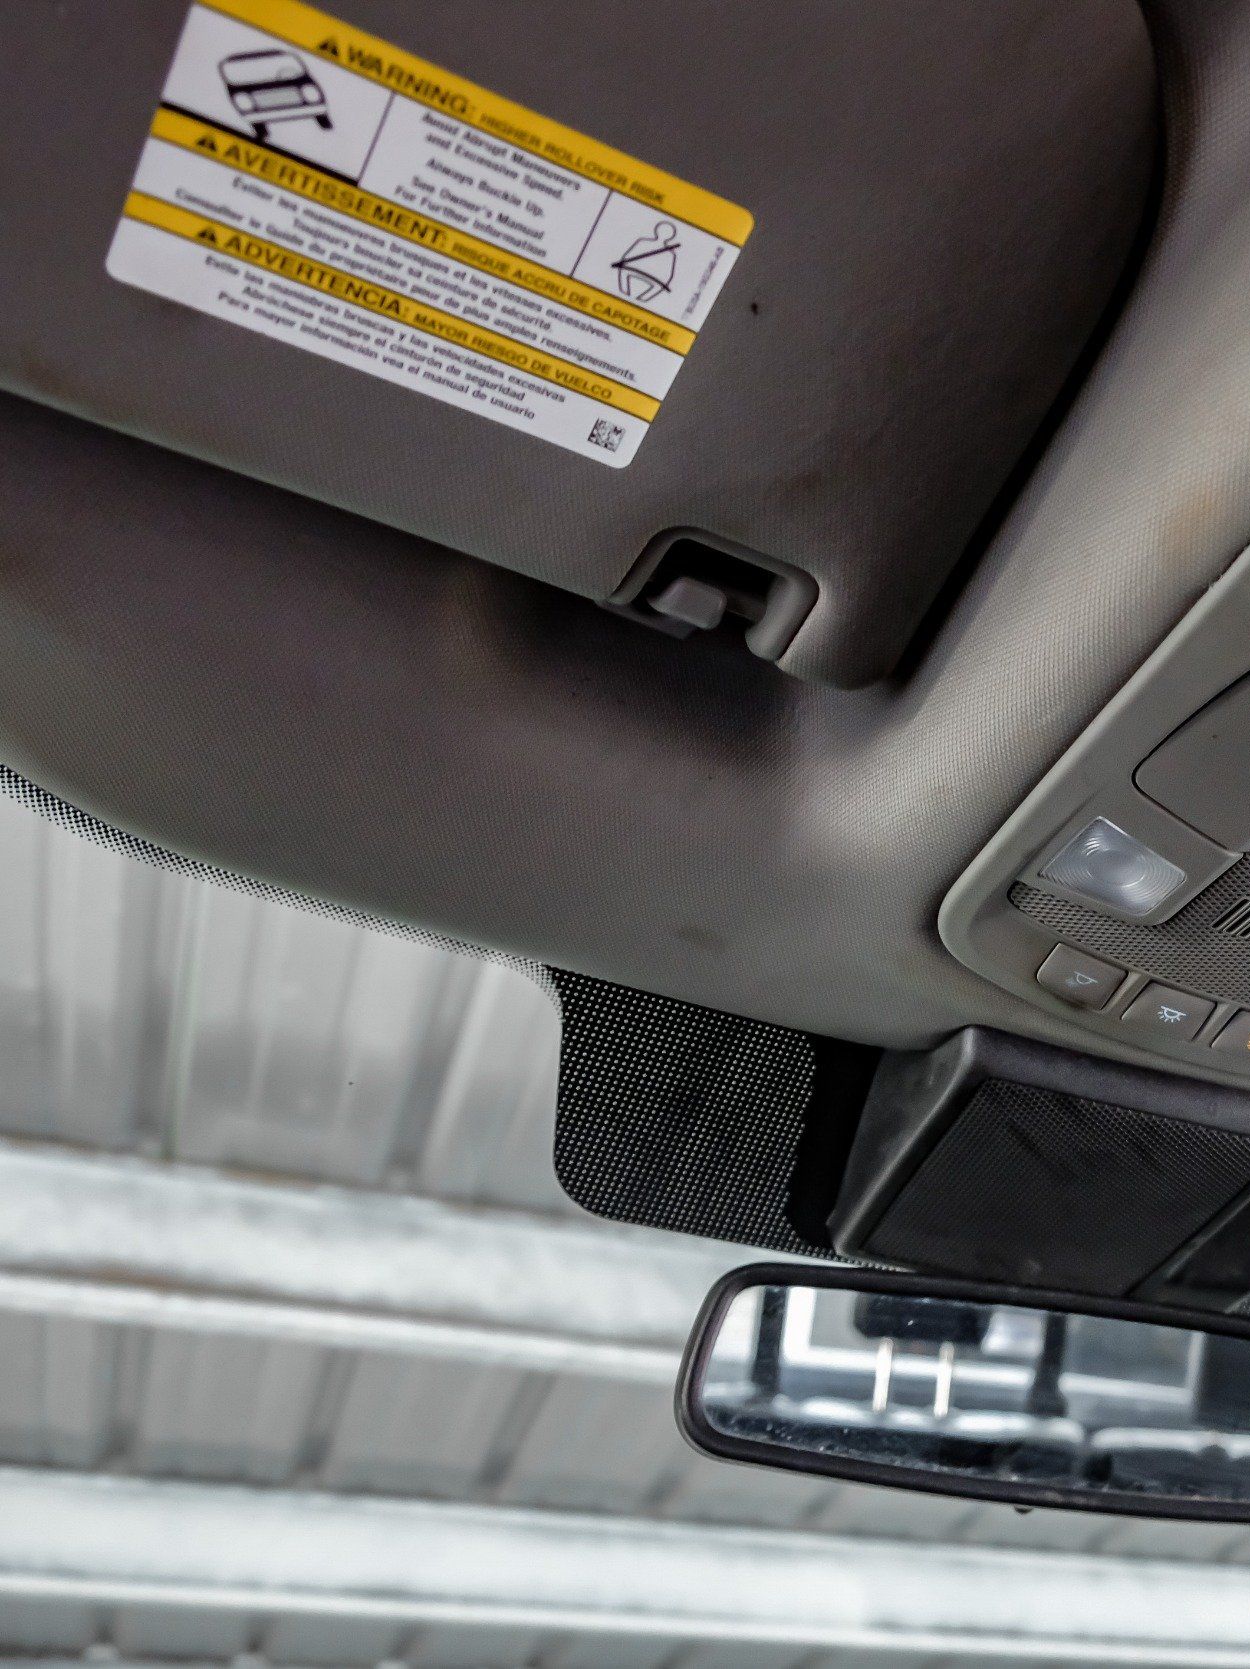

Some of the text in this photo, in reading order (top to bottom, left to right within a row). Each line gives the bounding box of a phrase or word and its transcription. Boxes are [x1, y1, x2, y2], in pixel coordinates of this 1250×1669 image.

[344, 45, 665, 204] WARNING: HIGHER ROLLOVER RISK
[224, 140, 671, 342] AVERTISSEMENT: RISQUE ACCRU DE CAPOTAGE
[495, 212, 545, 240] Manual
[224, 232, 613, 400] ADVERTENCIA: MAYOR RIESGO DE VUELCO
[407, 363, 419, 374] el
[422, 369, 469, 393] manual
[471, 388, 488, 400] de
[490, 395, 535, 419] usuario
[463, 370, 525, 401] seguridad
[507, 373, 566, 403] excesivas
